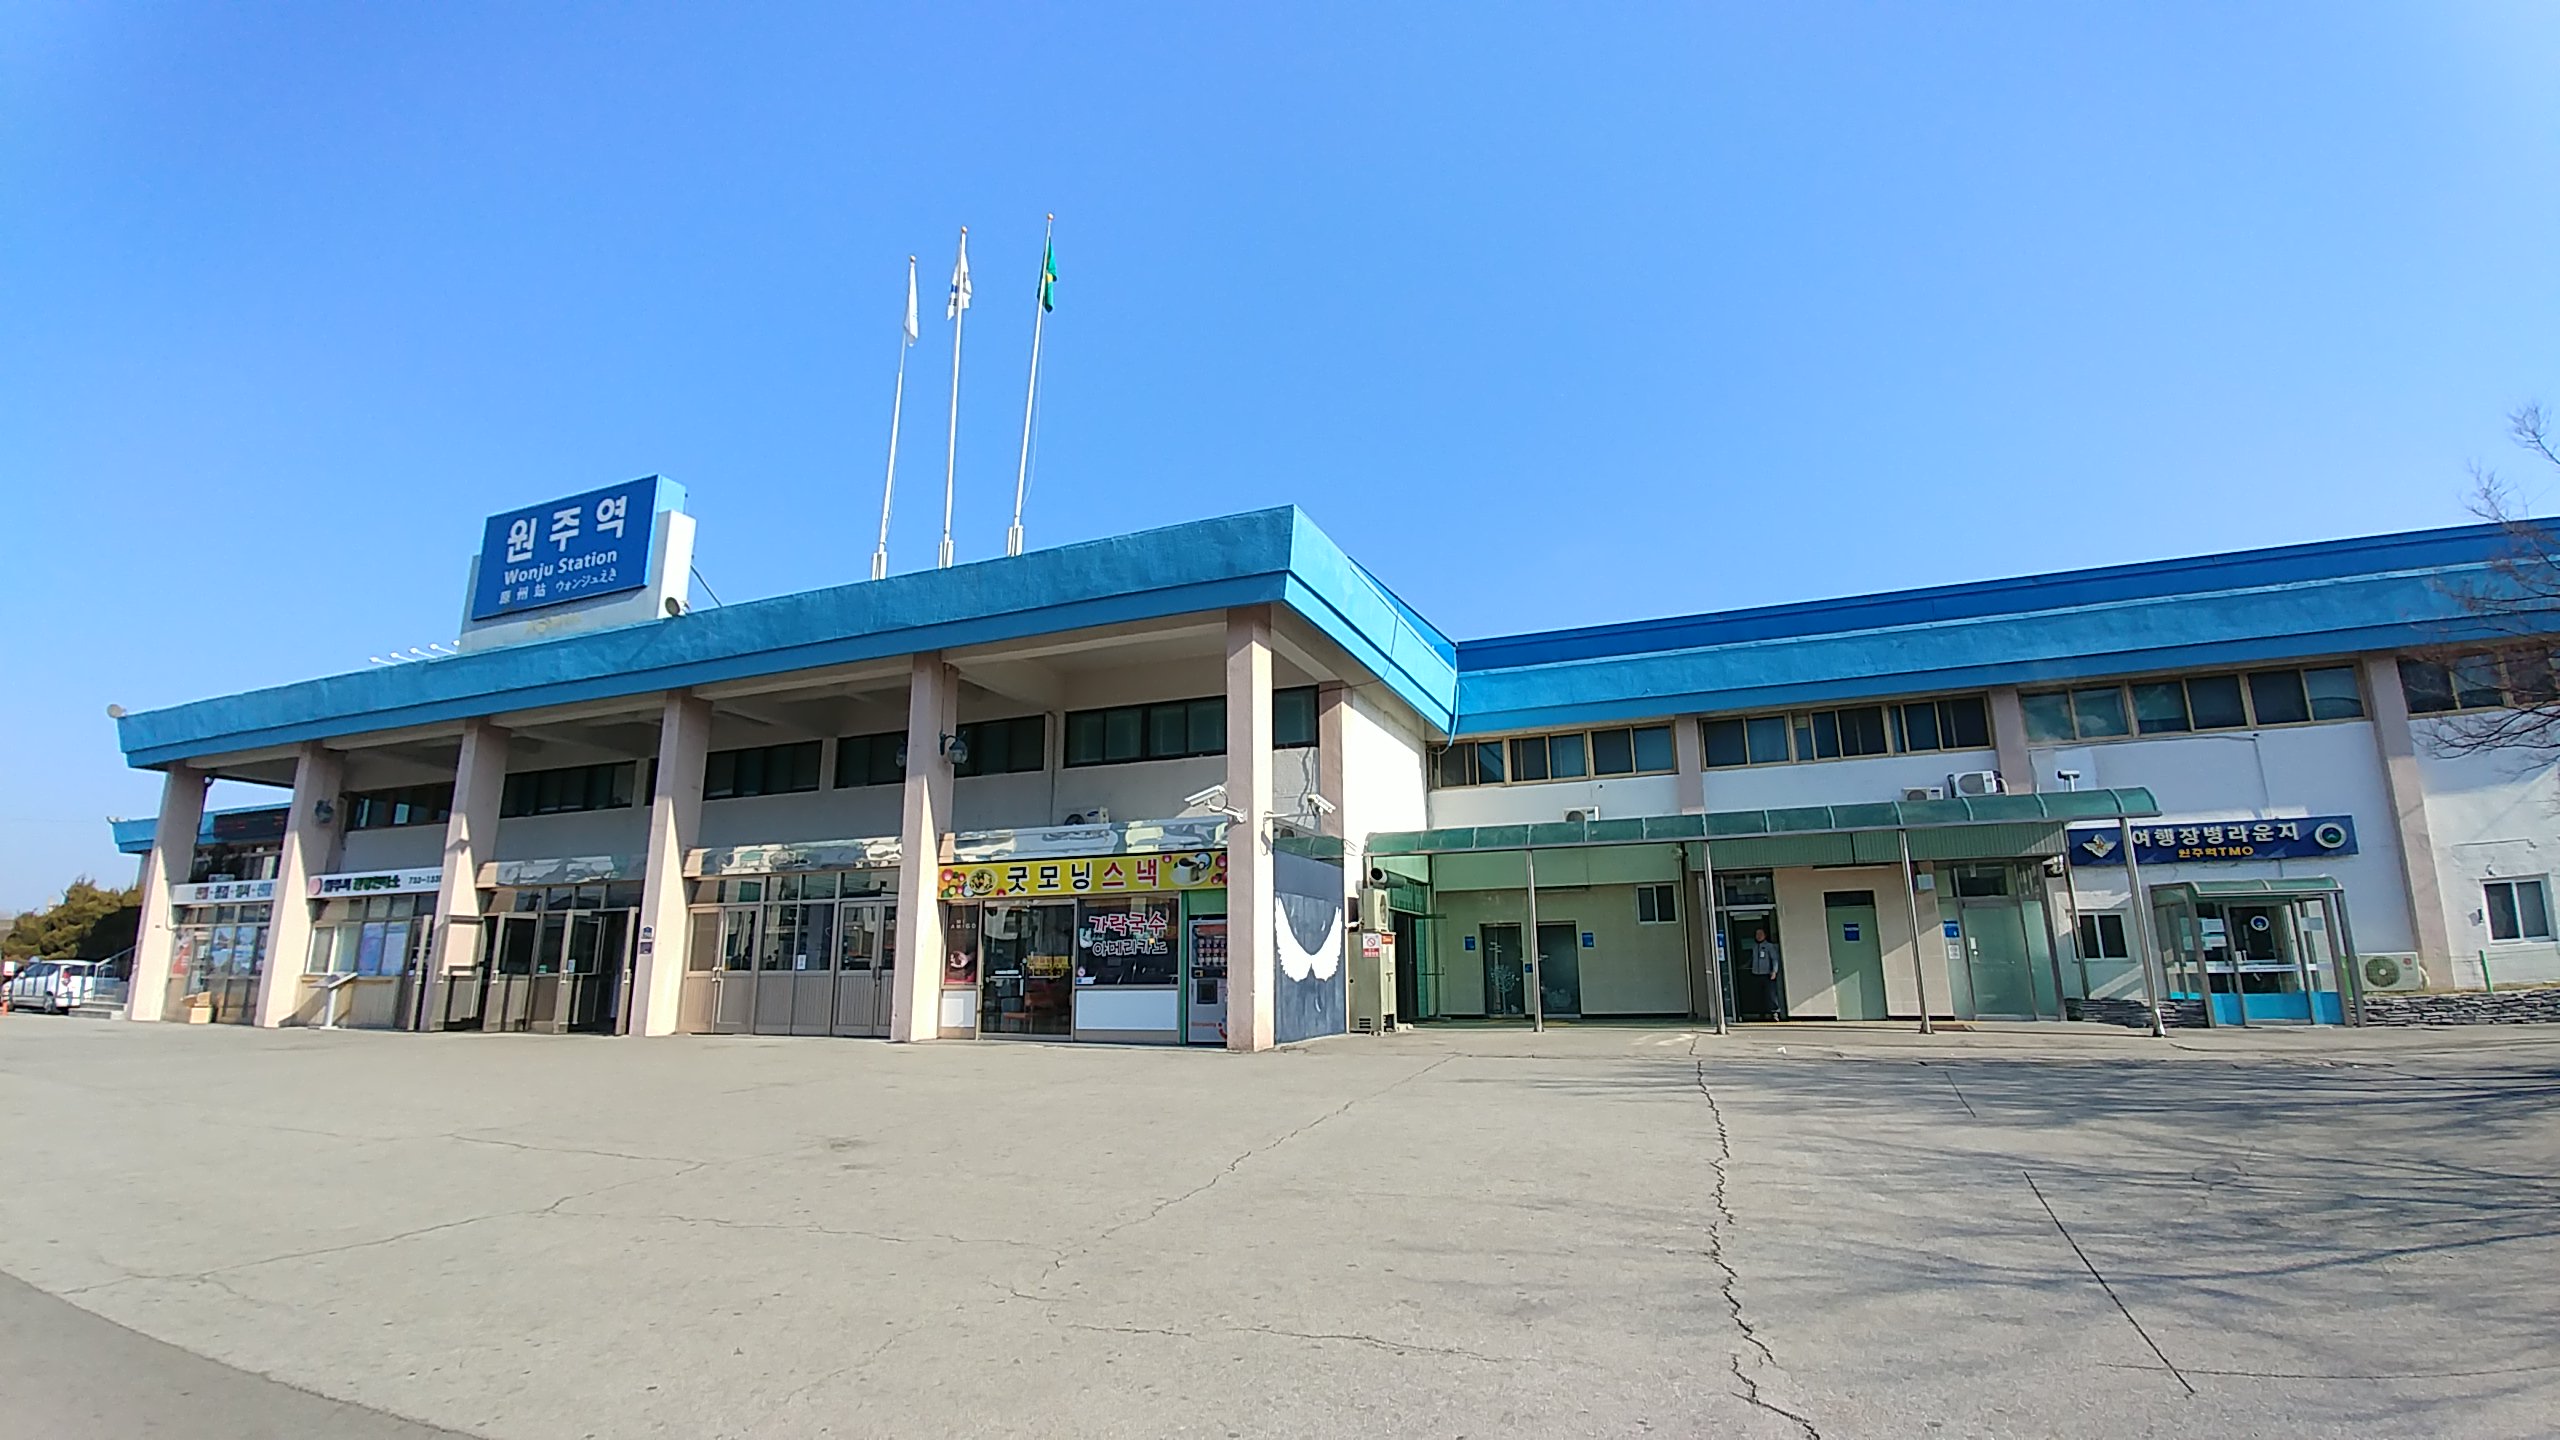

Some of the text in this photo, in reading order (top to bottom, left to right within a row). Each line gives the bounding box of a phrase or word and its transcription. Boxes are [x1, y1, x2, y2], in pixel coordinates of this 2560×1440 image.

[505, 495, 628, 565] 원주역
[504, 550, 618, 586] Wonju Station
[556, 567, 617, 592] ウォンジュえき
[2131, 821, 2300, 848] 여행장병라운지
[2178, 846, 2255, 859] 원주역TMO
[1006, 858, 1158, 893] 굿모닝스낵
[1088, 910, 1168, 937] 가락국수
[1091, 938, 1169, 957] 아메리카노
